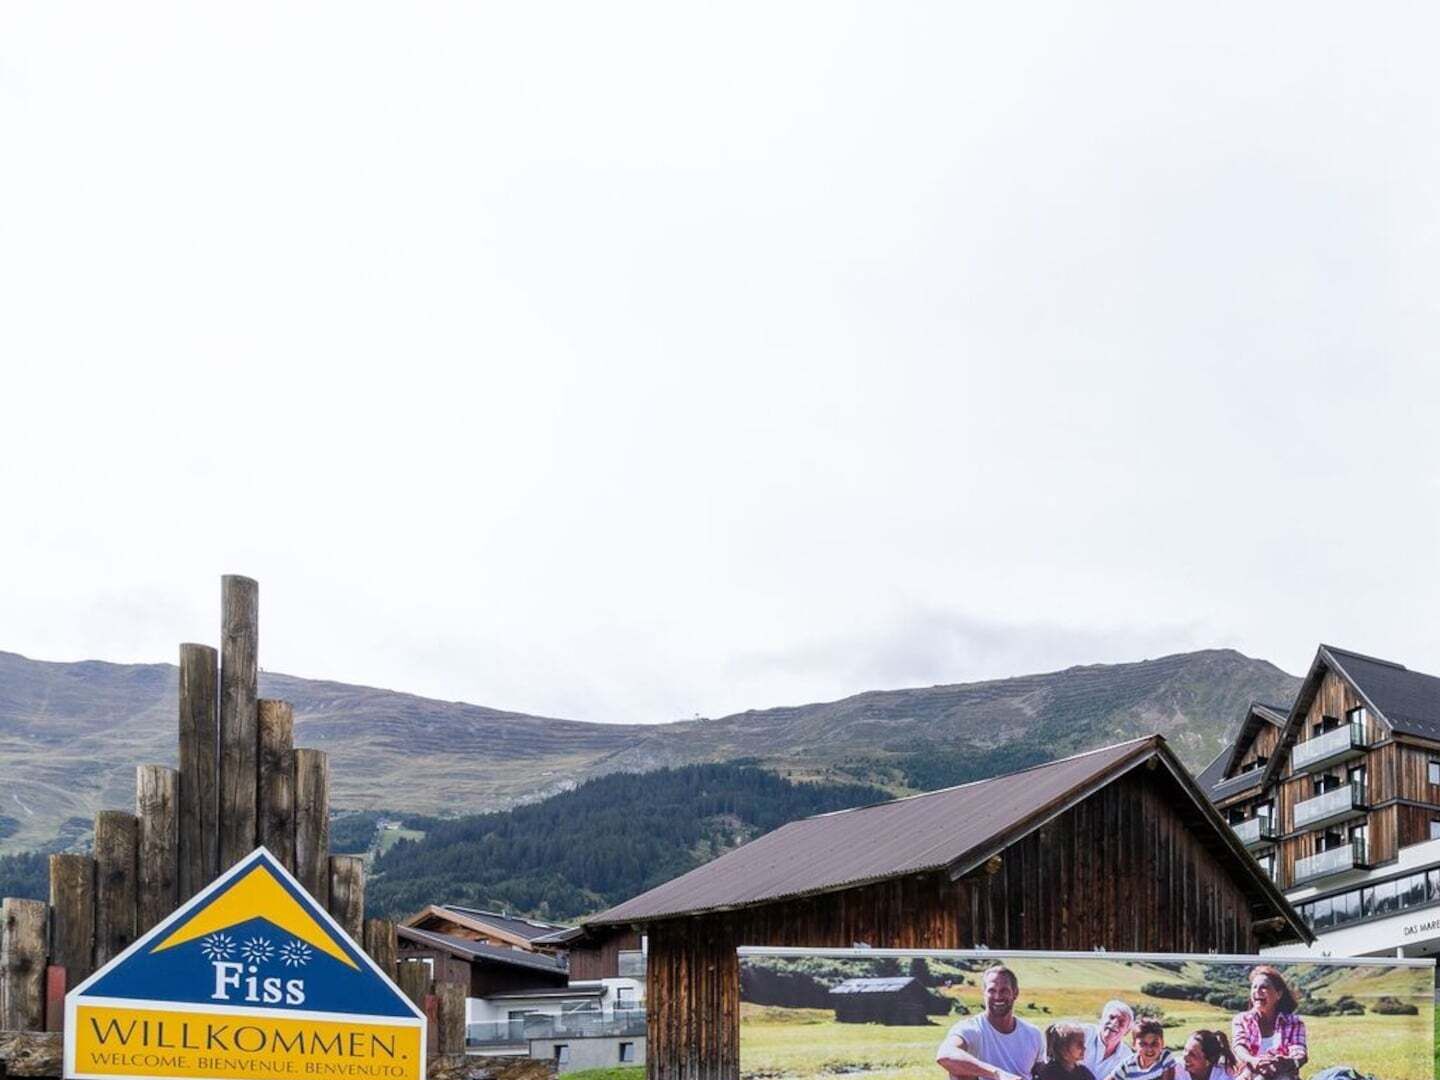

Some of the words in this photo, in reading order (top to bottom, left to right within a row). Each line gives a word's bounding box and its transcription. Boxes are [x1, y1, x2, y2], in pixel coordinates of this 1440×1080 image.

[1404, 925, 1418, 936] DAS
[211, 960, 306, 1005] Fiss
[90, 1017, 409, 1060] WILLKOMMEN.
[90, 1053, 190, 1069] WELCOME.
[197, 1057, 298, 1074] BIENVENUE.
[305, 1062, 408, 1078] BENVENUTO.
